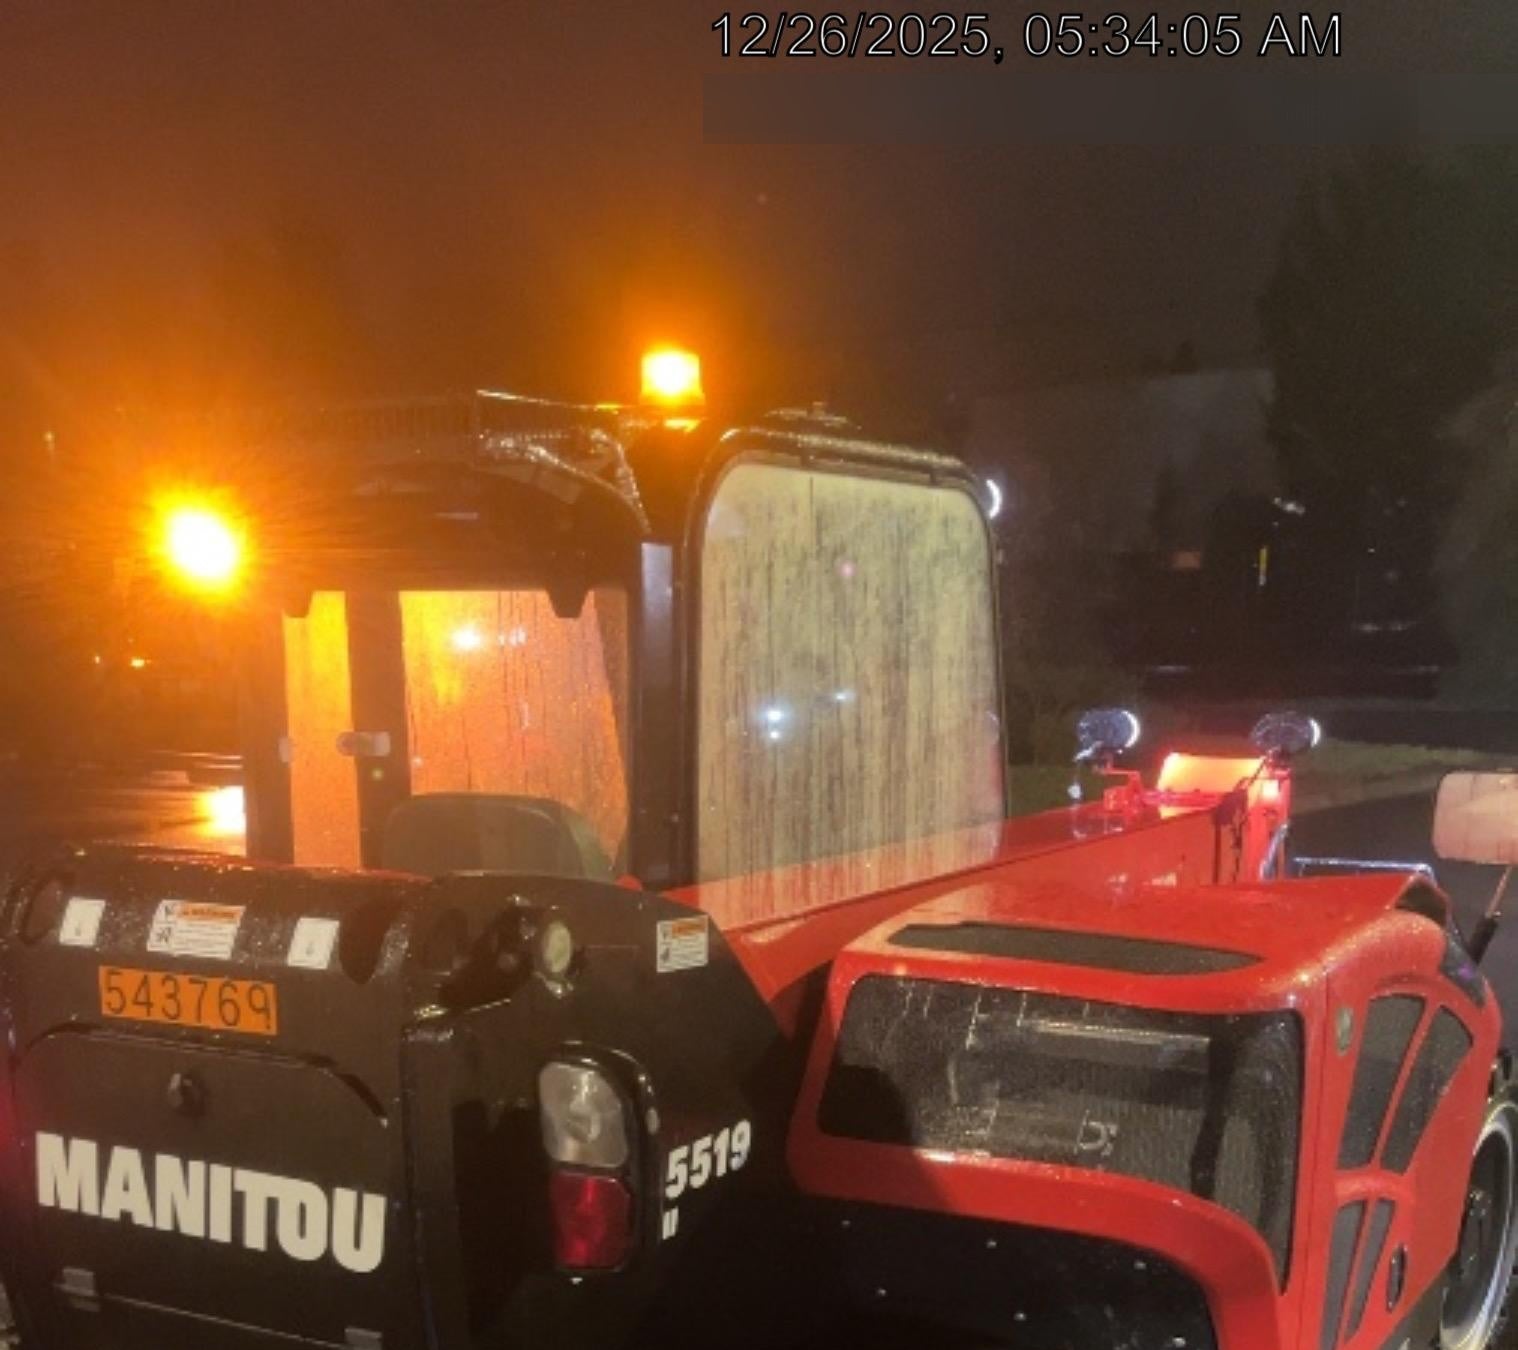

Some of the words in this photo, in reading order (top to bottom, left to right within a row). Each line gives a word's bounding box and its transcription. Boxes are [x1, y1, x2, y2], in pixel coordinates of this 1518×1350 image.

[104, 970, 273, 1031] 543769
[664, 1119, 752, 1200] 5519
[36, 1131, 388, 1274] MANITOU
